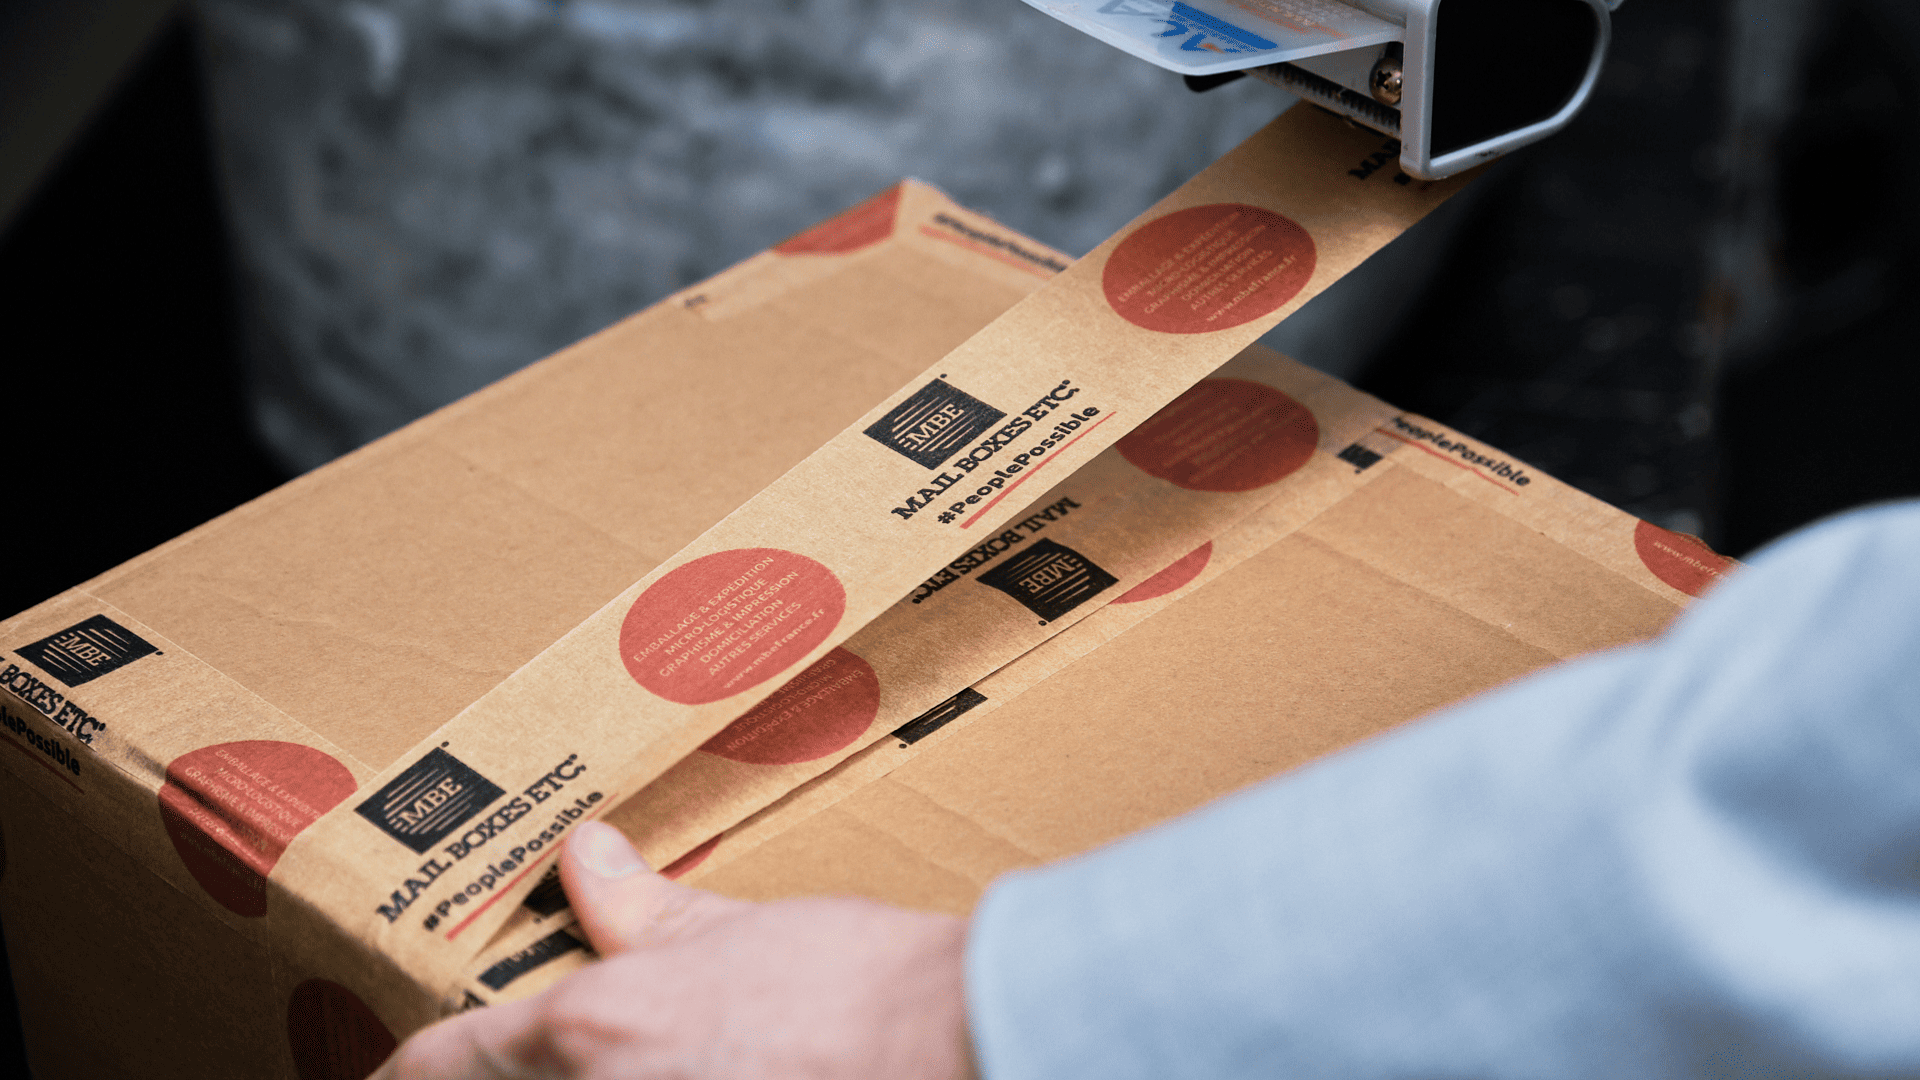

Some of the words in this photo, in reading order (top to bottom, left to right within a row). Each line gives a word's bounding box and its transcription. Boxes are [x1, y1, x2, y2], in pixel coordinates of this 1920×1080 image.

[908, 402, 965, 447] MBE
[890, 472, 964, 520] MAIL
[953, 416, 1033, 473] BOXES
[936, 406, 1101, 525] #PeoplePossible
[1014, 496, 1082, 533] MAIL
[950, 529, 1026, 575] BOXES
[1018, 558, 1076, 594] MBE
[633, 612, 702, 663] EMBALLAGE
[708, 556, 775, 607] EXPÉDITION
[659, 627, 725, 678] GRAPHISME
[732, 571, 799, 622] IMPRESSION
[665, 577, 769, 656] MICRO-LOGISTIQUE
[699, 599, 784, 665] DOMICILIATION
[708, 639, 753, 676] AUTRES
[749, 601, 802, 643] SERVICES
[62, 632, 112, 667] MBE
[723, 607, 826, 689] www.mbefrance.fr
[0, 663, 65, 715] BOXES
[800, 669, 864, 709] EMBALLAGE
[0, 705, 81, 776] lePossible
[215, 749, 272, 787] EMBALLAGE
[184, 766, 240, 808] GRAPHISME
[400, 777, 463, 826] MBE
[374, 858, 454, 925] MAIL
[444, 796, 534, 862] BOXES
[421, 791, 605, 933] #PeoplePossible
